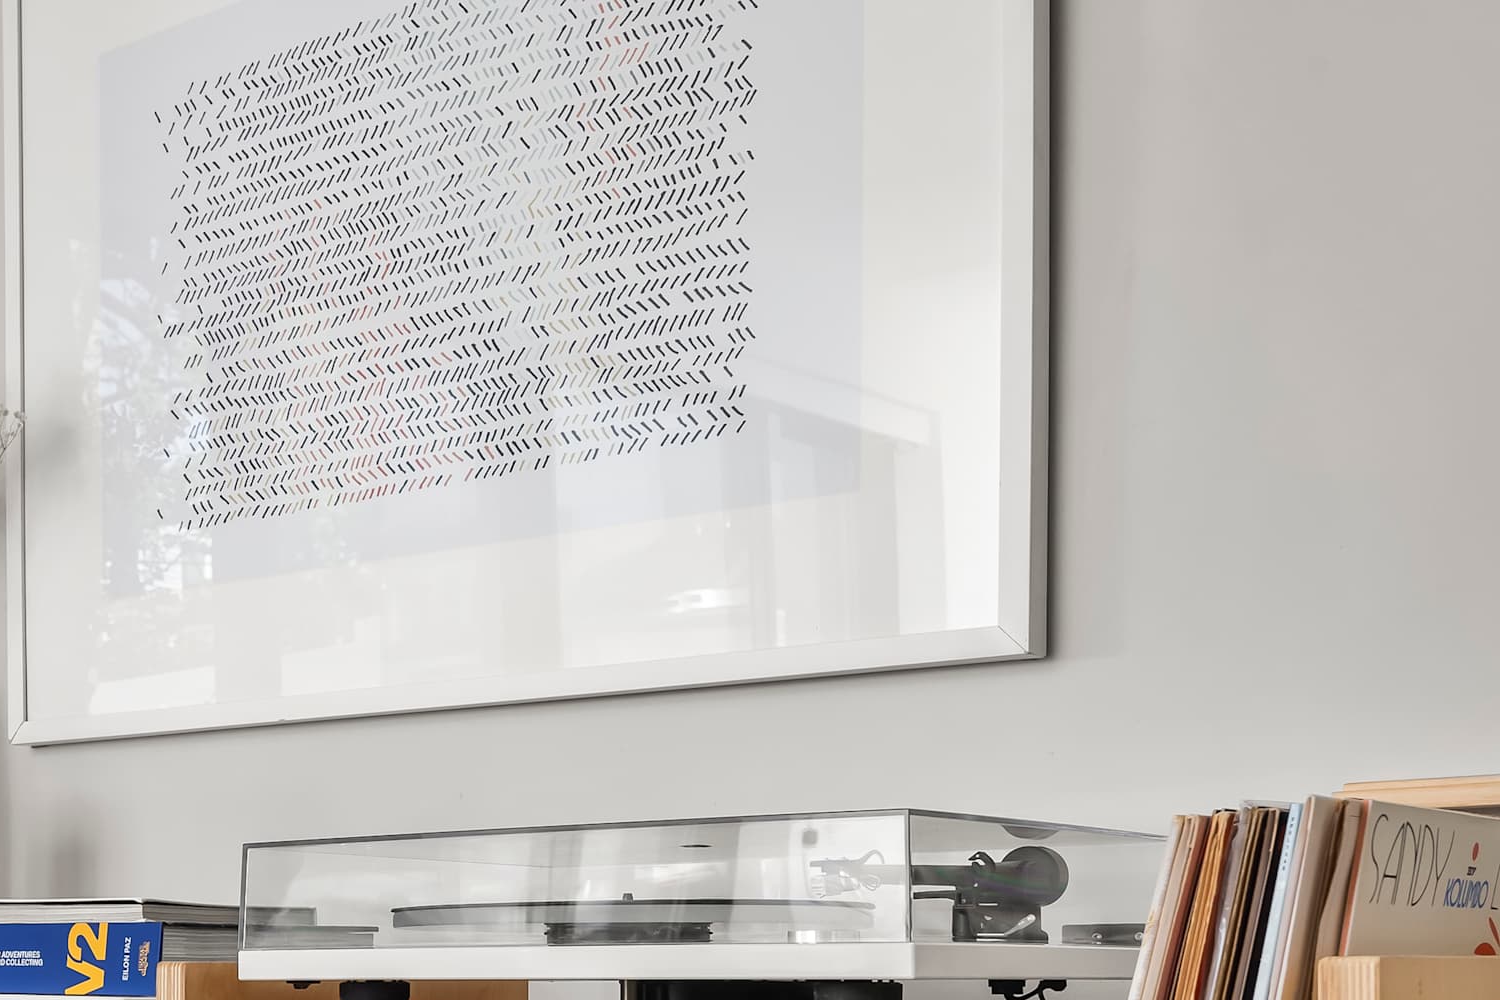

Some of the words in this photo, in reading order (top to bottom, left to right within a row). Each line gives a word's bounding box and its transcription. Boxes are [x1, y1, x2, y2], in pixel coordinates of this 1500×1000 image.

[1369, 813, 1456, 907] SANDY
[1, 950, 41, 959] ADVENTURES
[124, 937, 132, 954] PAZ
[5, 958, 44, 967] COLLECTING
[64, 921, 108, 995] V2
[122, 955, 130, 981] EILON
